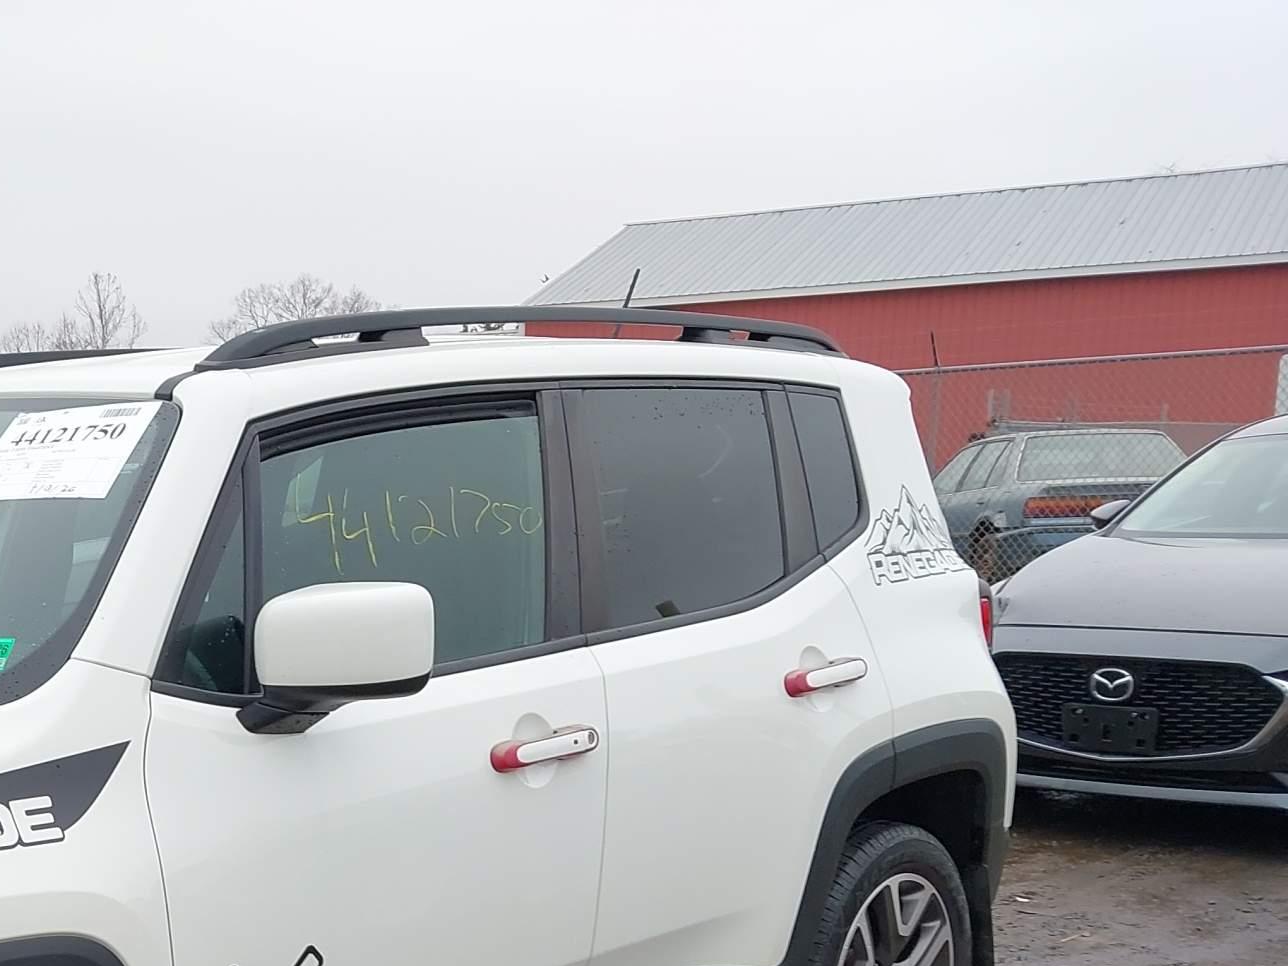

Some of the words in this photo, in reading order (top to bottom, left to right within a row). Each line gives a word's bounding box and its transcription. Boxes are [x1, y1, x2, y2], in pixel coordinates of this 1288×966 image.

[11, 422, 127, 447] 44121750
[295, 472, 543, 576] 44121750
[867, 547, 975, 586] RENEGAD
